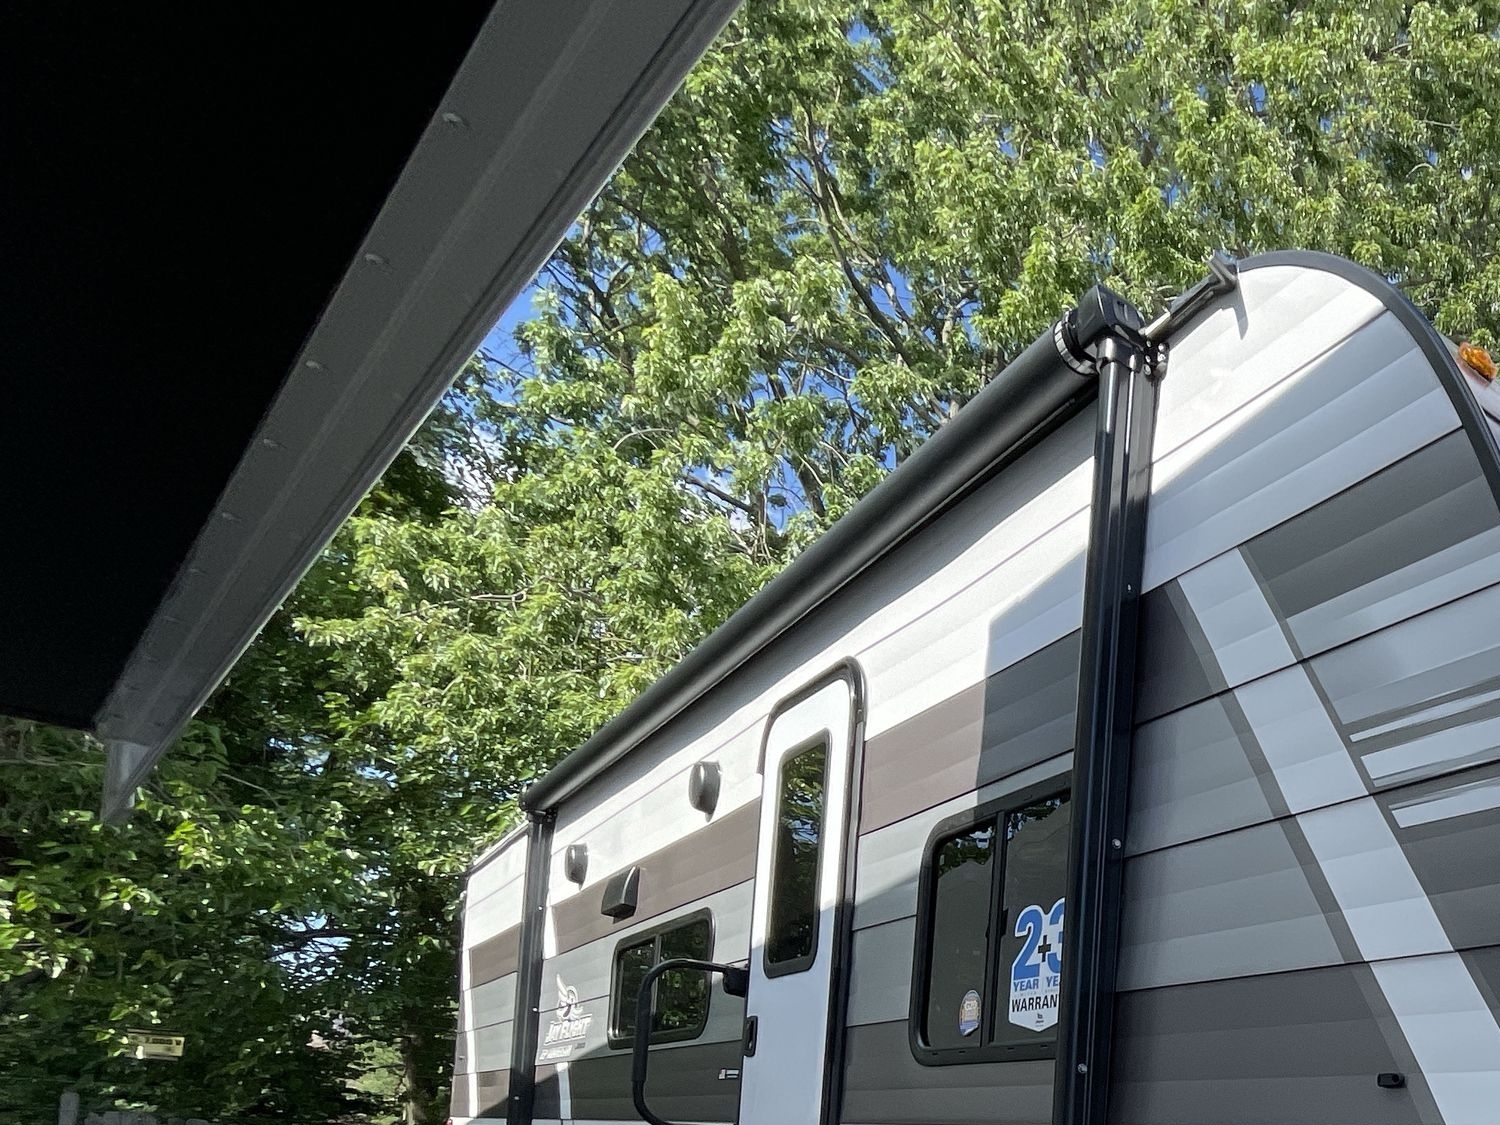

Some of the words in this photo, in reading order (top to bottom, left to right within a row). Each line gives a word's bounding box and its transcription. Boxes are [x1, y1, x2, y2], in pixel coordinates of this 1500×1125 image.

[1013, 978, 1039, 992] YEAR
[1046, 975, 1060, 988] YE
[1011, 993, 1058, 1013] WARRAN
